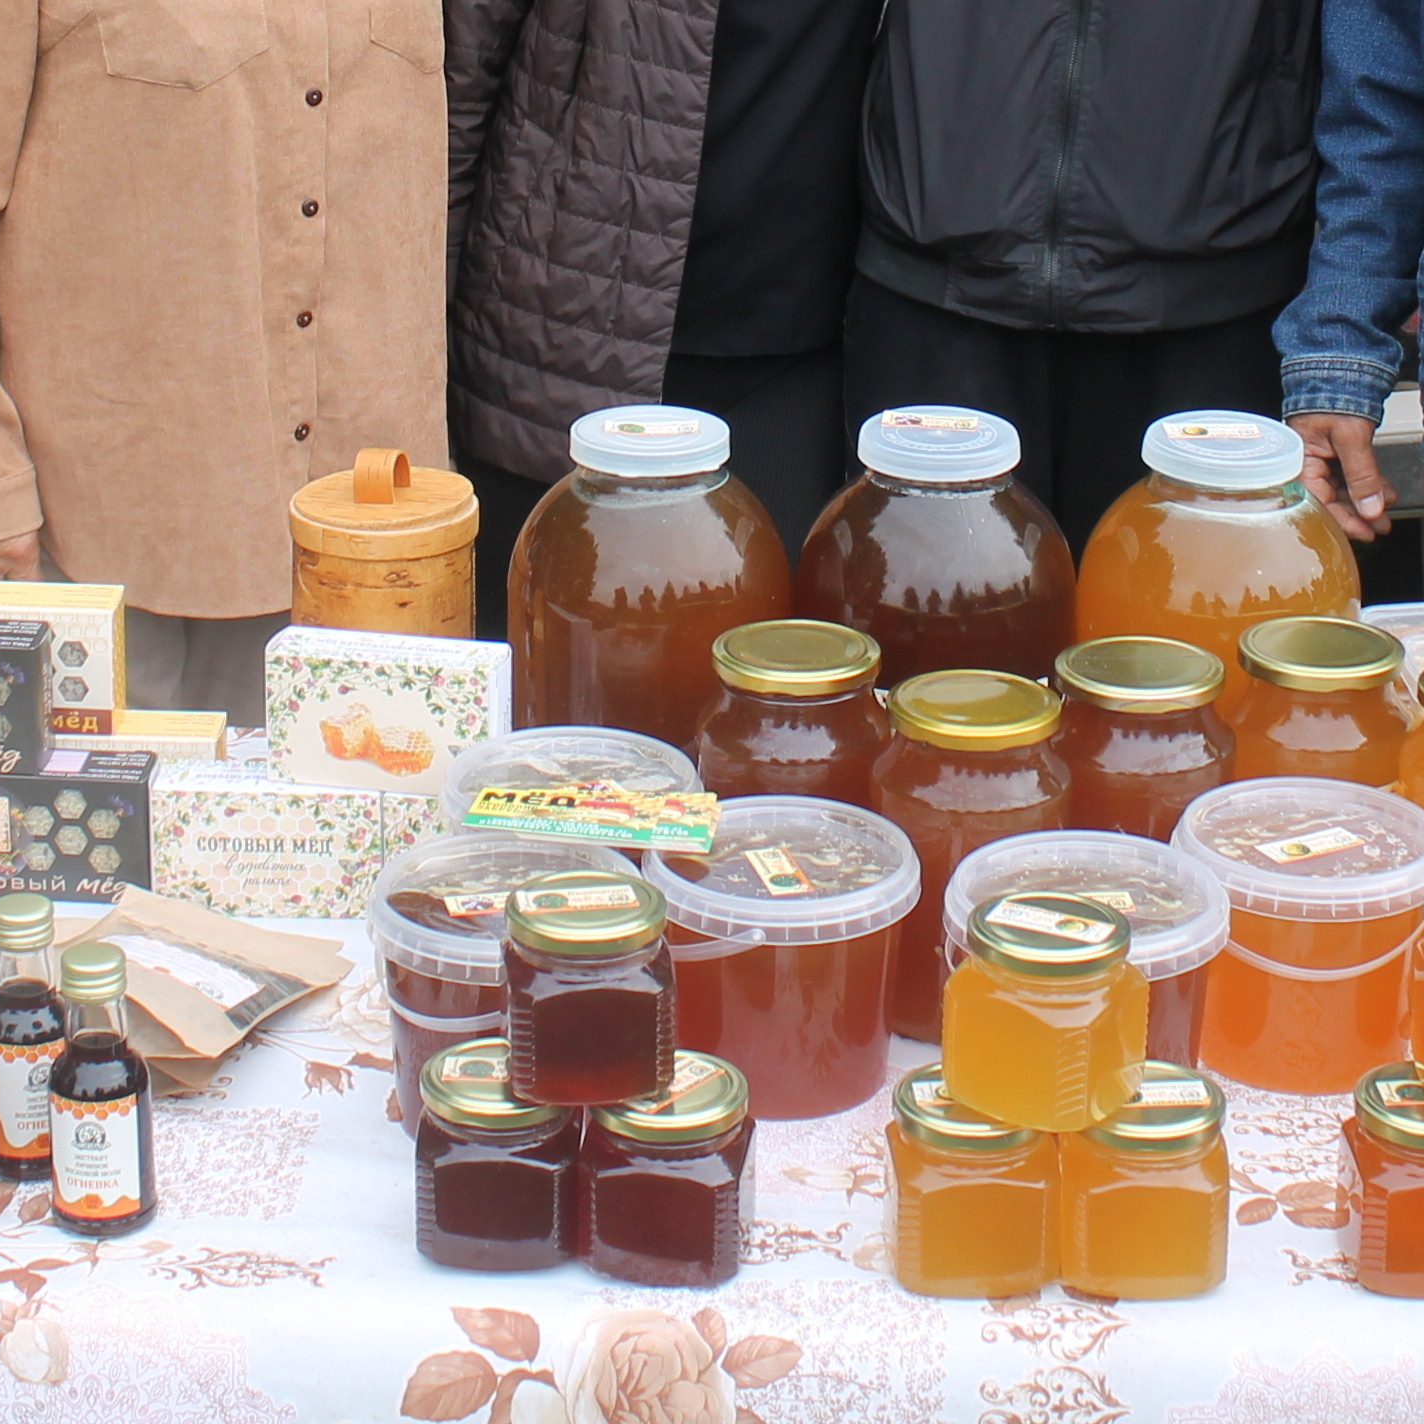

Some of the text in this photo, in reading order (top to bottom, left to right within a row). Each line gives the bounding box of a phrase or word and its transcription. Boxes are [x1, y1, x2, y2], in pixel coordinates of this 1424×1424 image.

[197, 834, 334, 857] СОТОВЫЙ МЁД
[225, 854, 238, 869] в
[76, 876, 128, 903] мёд
[17, 1120, 48, 1131] ОГНЕ
